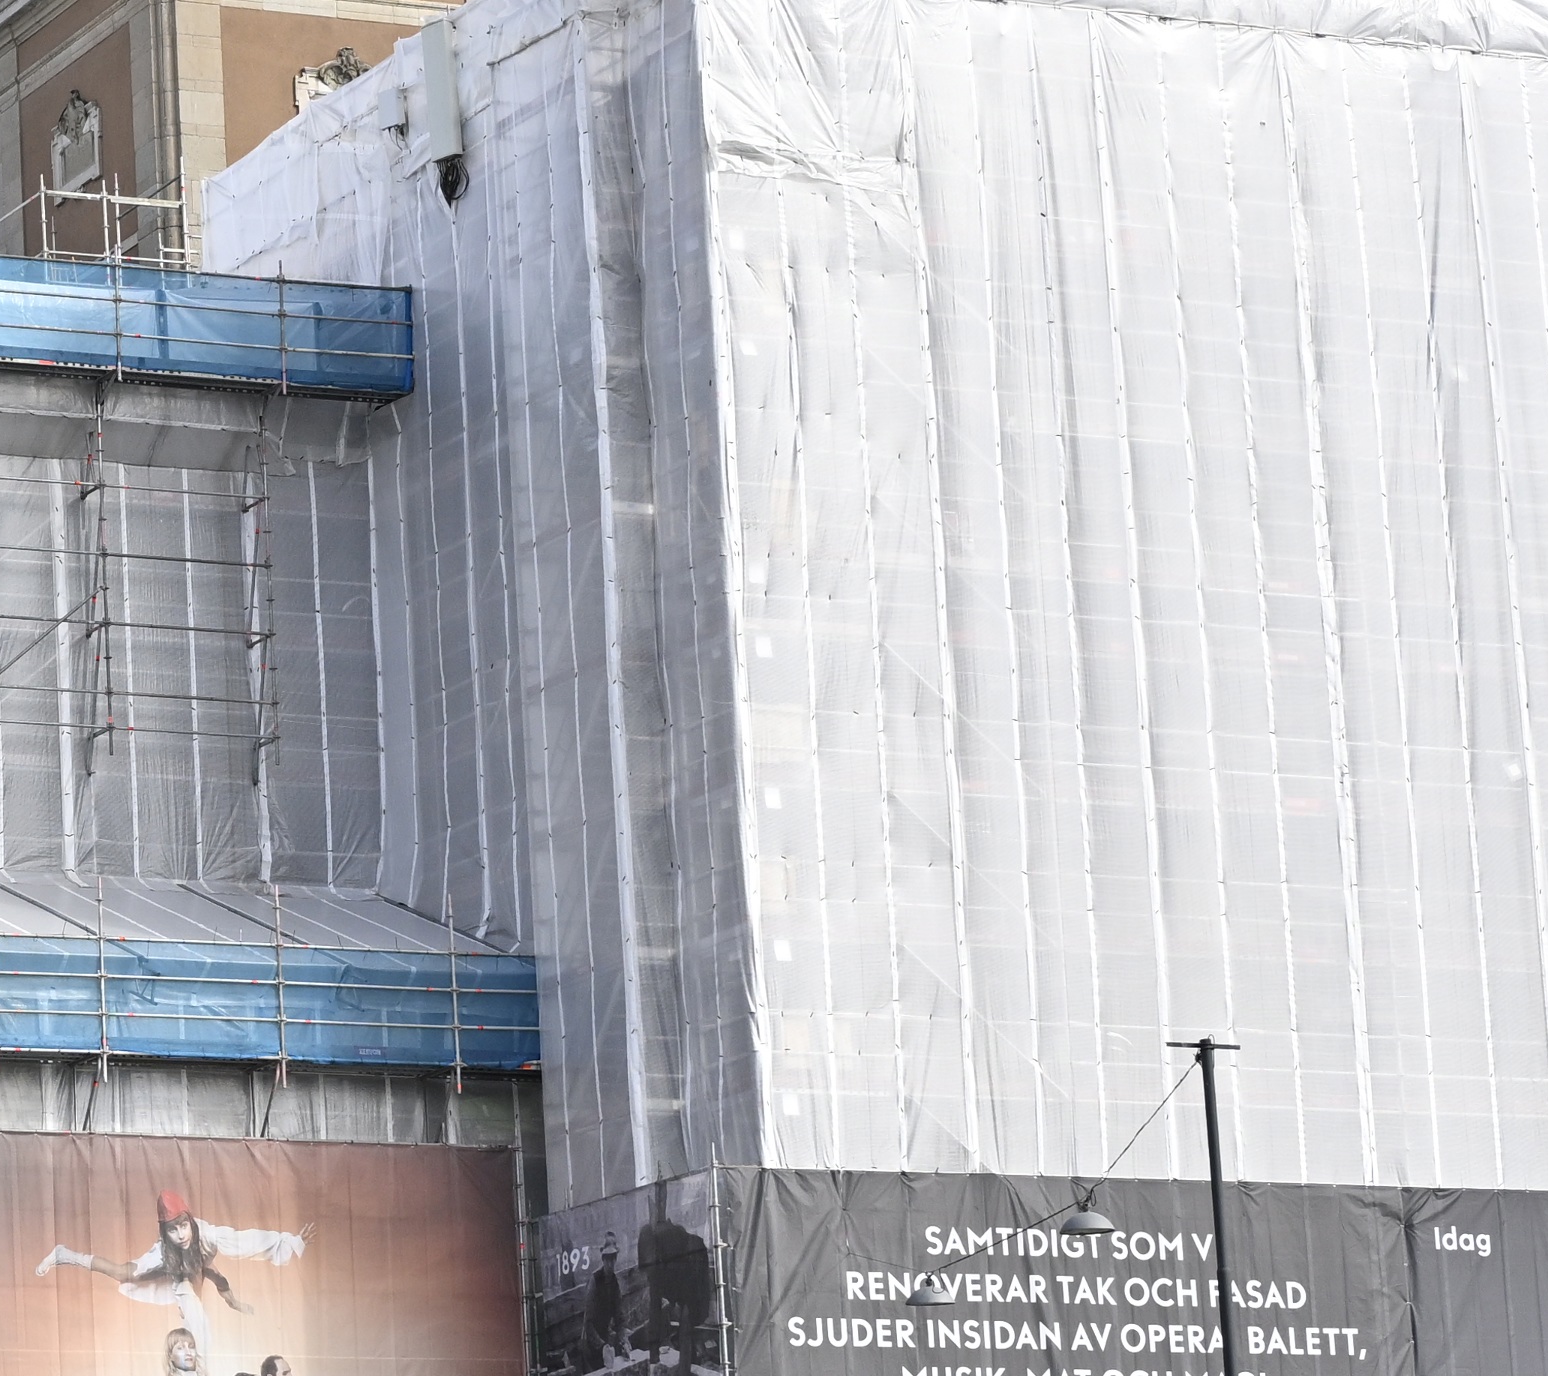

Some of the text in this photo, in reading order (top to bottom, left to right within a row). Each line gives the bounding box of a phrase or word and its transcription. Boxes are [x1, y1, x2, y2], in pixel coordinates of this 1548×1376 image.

[925, 1225, 1214, 1261] SAMTIDIGT SOM V
[1434, 1226, 1492, 1257] Idag
[556, 1246, 590, 1276] 1893
[846, 1271, 1048, 1304] RENOVERAR
[1056, 1275, 1117, 1306] TAK
[1124, 1277, 1198, 1308] OCH
[787, 1316, 916, 1348] SJUDER
[926, 1319, 1062, 1351] INSIDAN
[1071, 1323, 1112, 1352] AV
[1247, 1326, 1367, 1361] BALETT,
